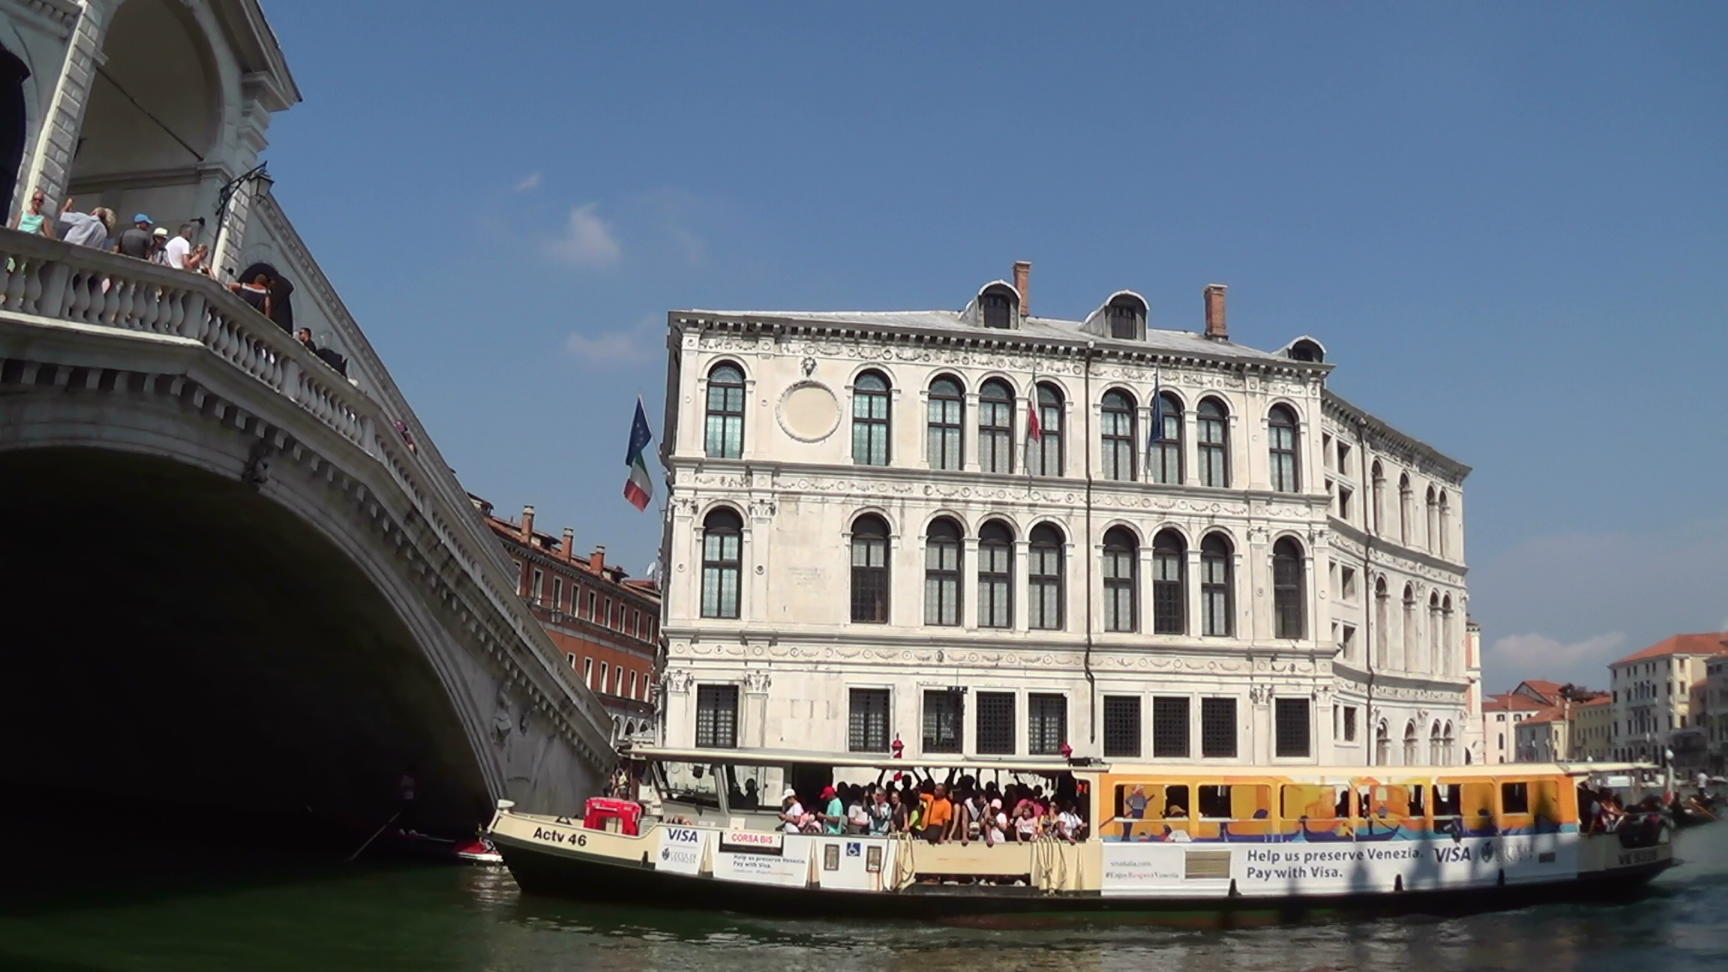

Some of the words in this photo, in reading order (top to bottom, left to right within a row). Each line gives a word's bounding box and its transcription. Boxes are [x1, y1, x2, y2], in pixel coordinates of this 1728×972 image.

[533, 827, 564, 843] Actv
[568, 834, 587, 847] 46
[668, 827, 698, 843] VISA
[731, 832, 759, 844] CORSA
[760, 835, 773, 844] BIS
[1247, 849, 1281, 864] Help
[1284, 851, 1300, 862] us
[1304, 850, 1364, 864] preserve
[1367, 847, 1424, 860] Venezia.
[1434, 847, 1472, 863] VISA
[1247, 866, 1273, 881] Pay
[1275, 866, 1307, 879] with
[1310, 866, 1344, 879] Visa.
